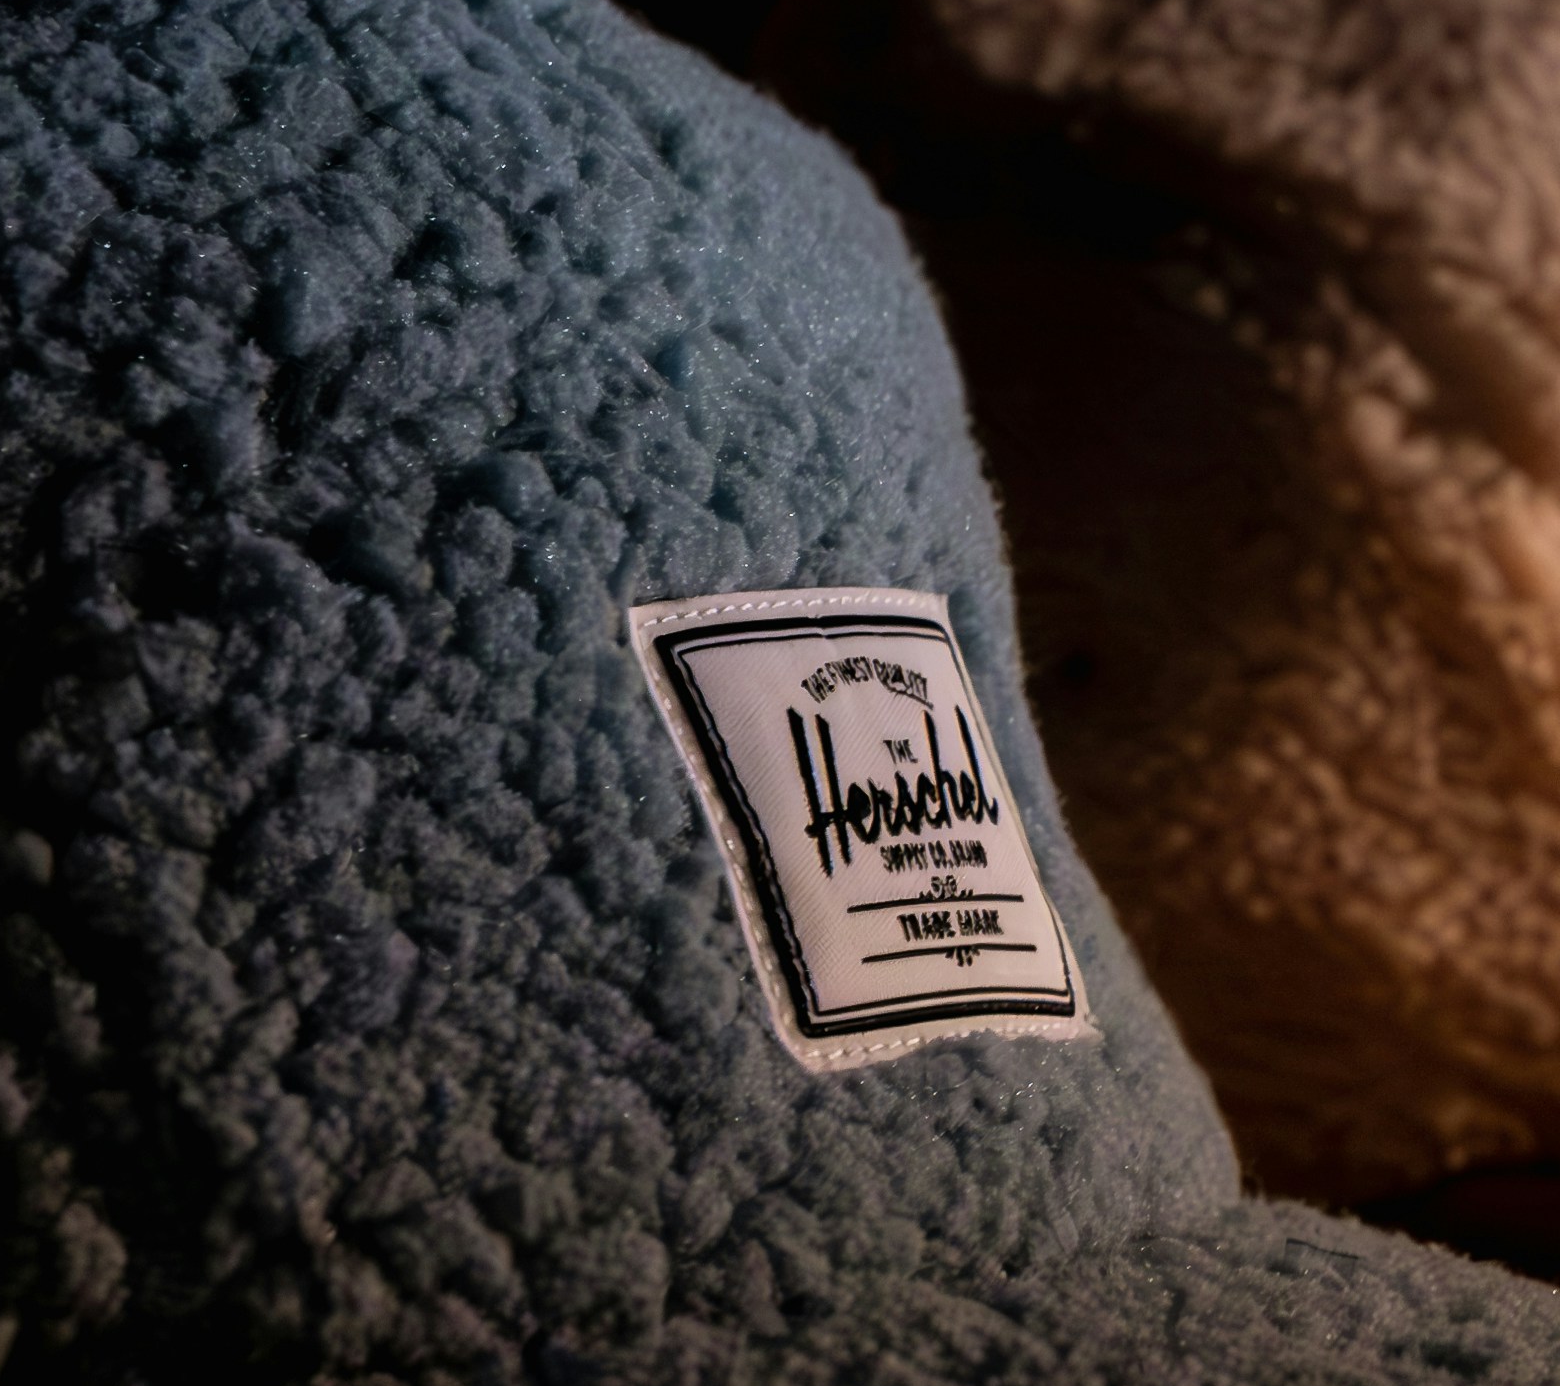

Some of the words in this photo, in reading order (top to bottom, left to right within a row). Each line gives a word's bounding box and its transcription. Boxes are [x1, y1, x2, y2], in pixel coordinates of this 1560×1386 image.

[801, 668, 835, 703] THE
[883, 739, 918, 764] THE
[786, 704, 998, 879] Herschel
[896, 911, 956, 942] TRADE
[957, 909, 1004, 936] MARK
